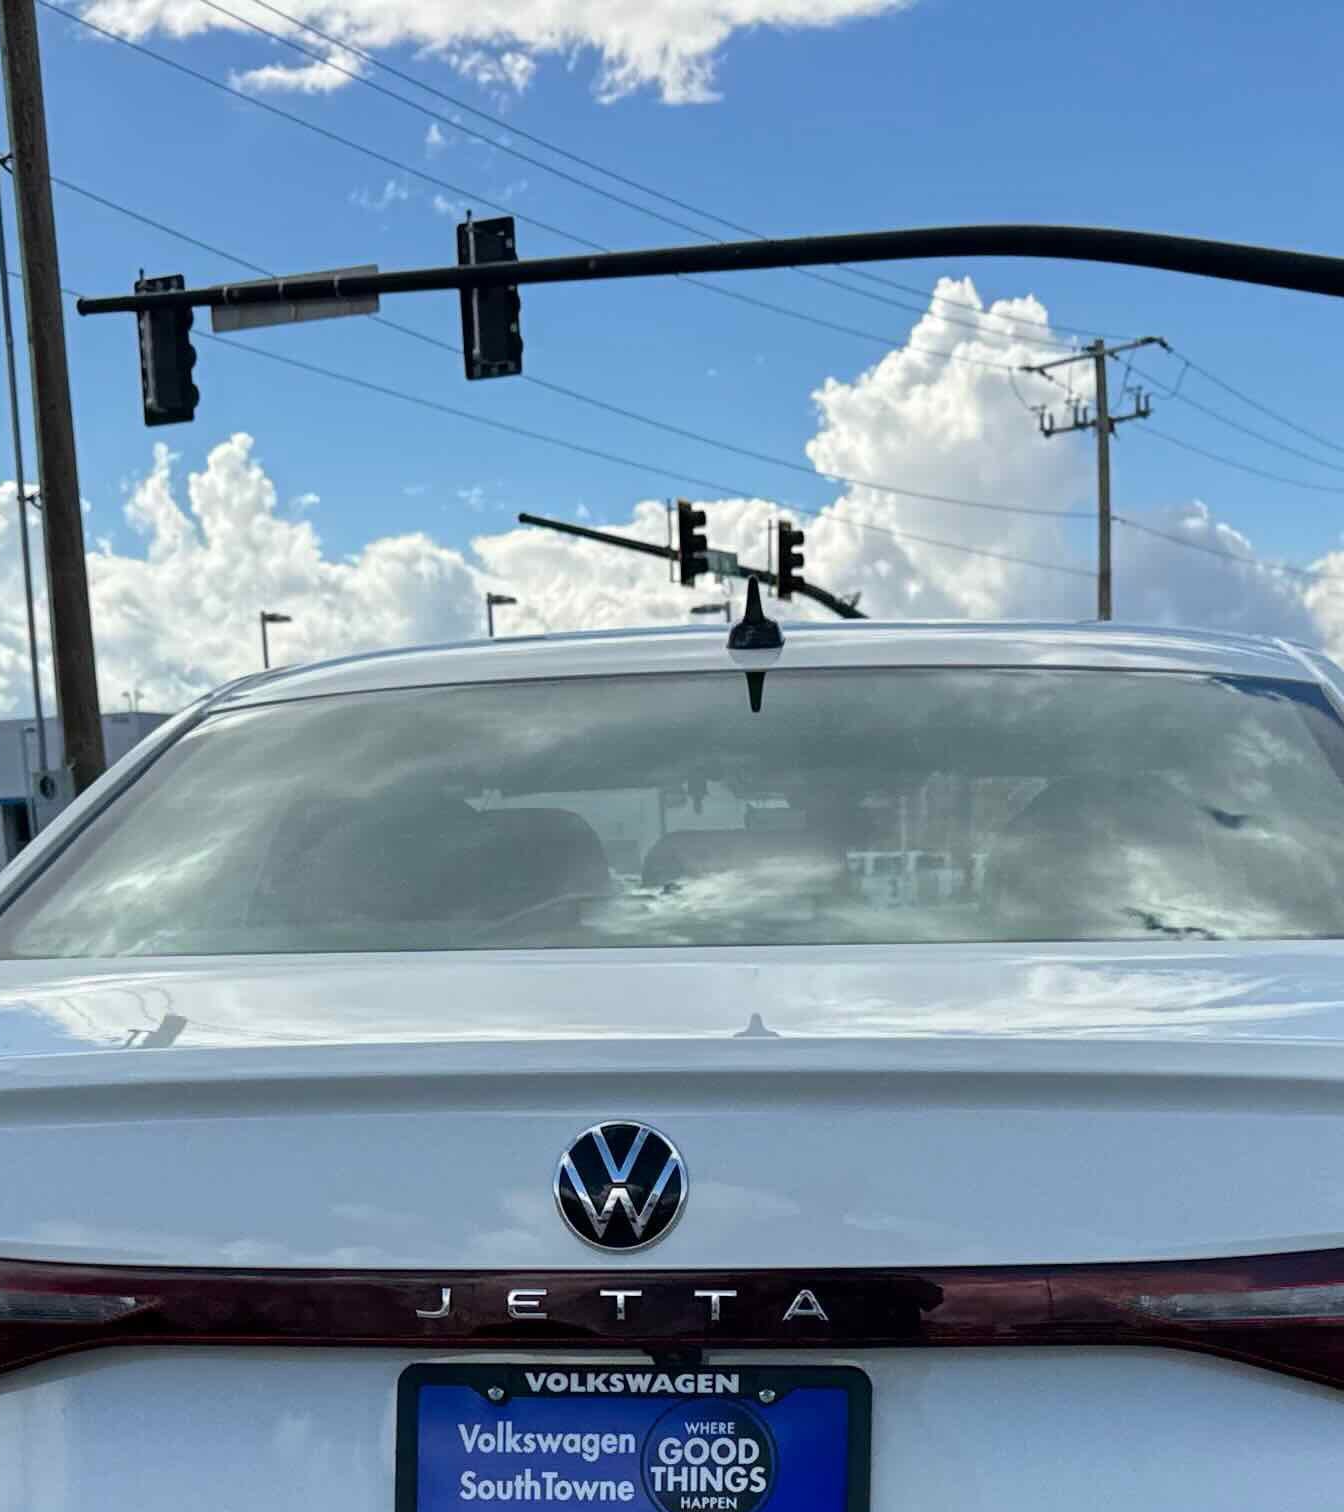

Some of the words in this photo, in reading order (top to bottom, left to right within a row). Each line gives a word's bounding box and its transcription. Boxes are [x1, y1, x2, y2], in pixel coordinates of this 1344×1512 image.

[554, 1121, 687, 1250] VW
[416, 1288, 829, 1321] JETTA
[524, 1372, 740, 1394] VOLKSWAGEN
[457, 1421, 636, 1462] Volkswagen
[684, 1421, 736, 1435] WHERE
[658, 1437, 760, 1465] GOOD
[650, 1466, 767, 1493] THINGS
[680, 1496, 738, 1510] HAPPEN
